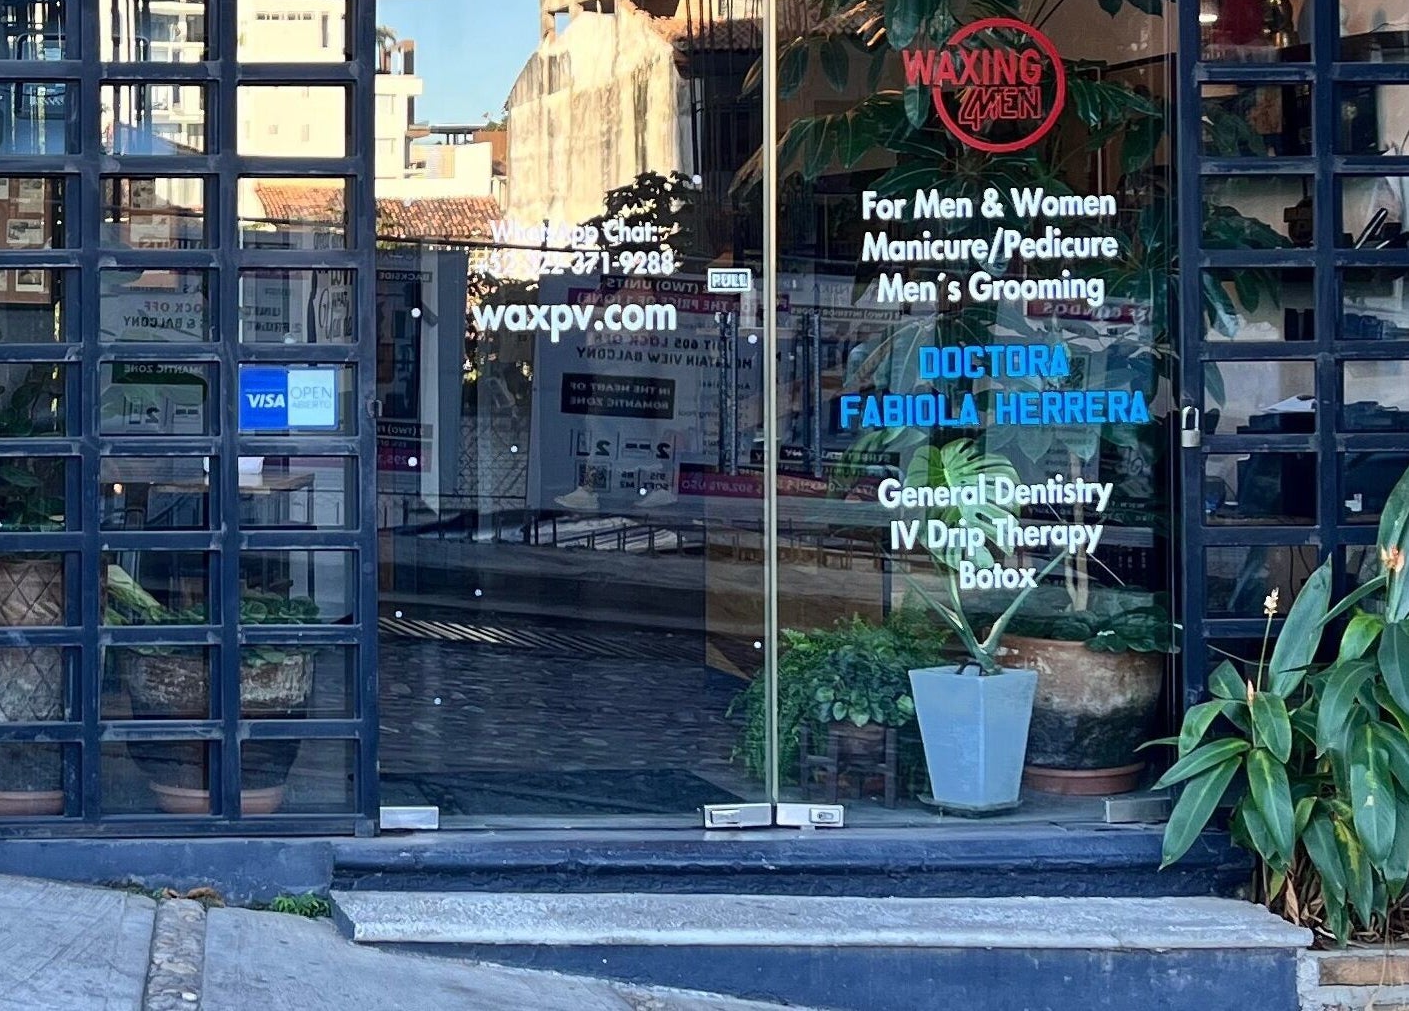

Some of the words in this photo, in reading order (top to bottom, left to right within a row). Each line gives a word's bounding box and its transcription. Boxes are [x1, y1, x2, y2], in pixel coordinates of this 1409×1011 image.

[903, 49, 1042, 86] WAXING
[958, 85, 1042, 131] 4MEN
[862, 191, 906, 220] For
[914, 189, 972, 219] Men
[981, 187, 1004, 218] &
[1011, 187, 1117, 217] Women
[604, 217, 658, 243] Chat:
[861, 226, 1119, 263] Manicure/Pedicure
[711, 271, 748, 288] PULL
[969, 270, 1104, 306] Grooming
[472, 303, 677, 342] waxpv.com
[919, 344, 1069, 379] DOCTORA
[246, 393, 285, 408] VISA
[290, 387, 332, 399] OPEN
[840, 392, 979, 428] FABIOLA
[995, 390, 1149, 425] HERRERA
[878, 475, 985, 508] General
[995, 474, 1113, 511] Dentistry
[890, 520, 919, 550] IV
[928, 518, 985, 556] Drip
[992, 518, 1103, 553] Therapy
[959, 560, 1037, 589] Botox
